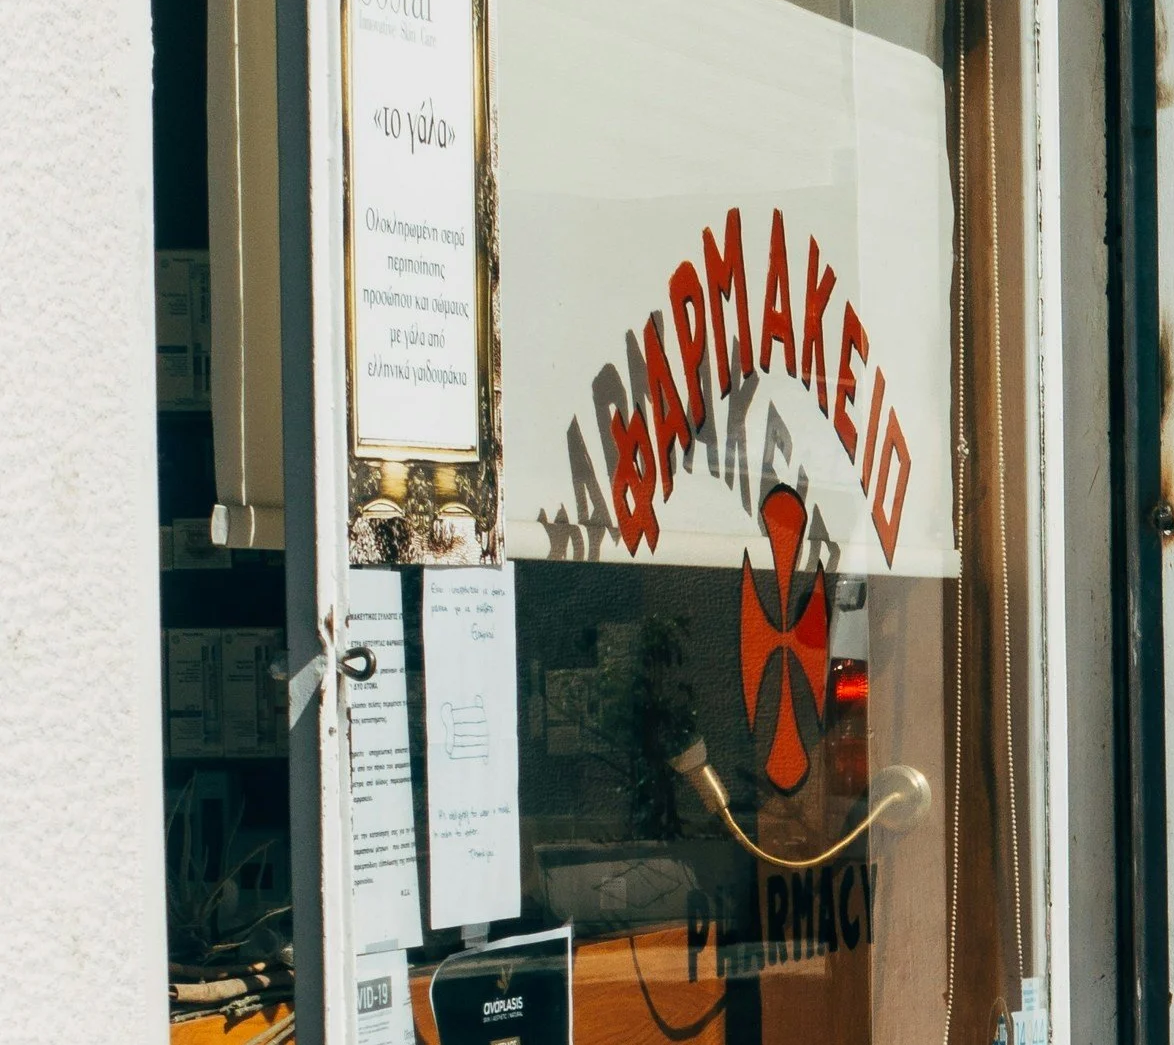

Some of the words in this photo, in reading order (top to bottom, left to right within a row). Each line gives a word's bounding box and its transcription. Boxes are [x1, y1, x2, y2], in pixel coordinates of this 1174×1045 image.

[365, 207, 439, 244] Ολοκληρωμένη
[441, 226, 465, 250] σειρά
[363, 286, 412, 310] προσώπου
[415, 296, 429, 311] και
[431, 293, 470, 320] σώματος
[389, 327, 402, 348] με
[404, 322, 425, 349] γάλα
[428, 329, 446, 349] από
[367, 353, 410, 380] ελληνικά
[611, 207, 911, 570] ΦΑΡΜΑΚΕΙΟ
[358, 983, 388, 1010] VID-19
